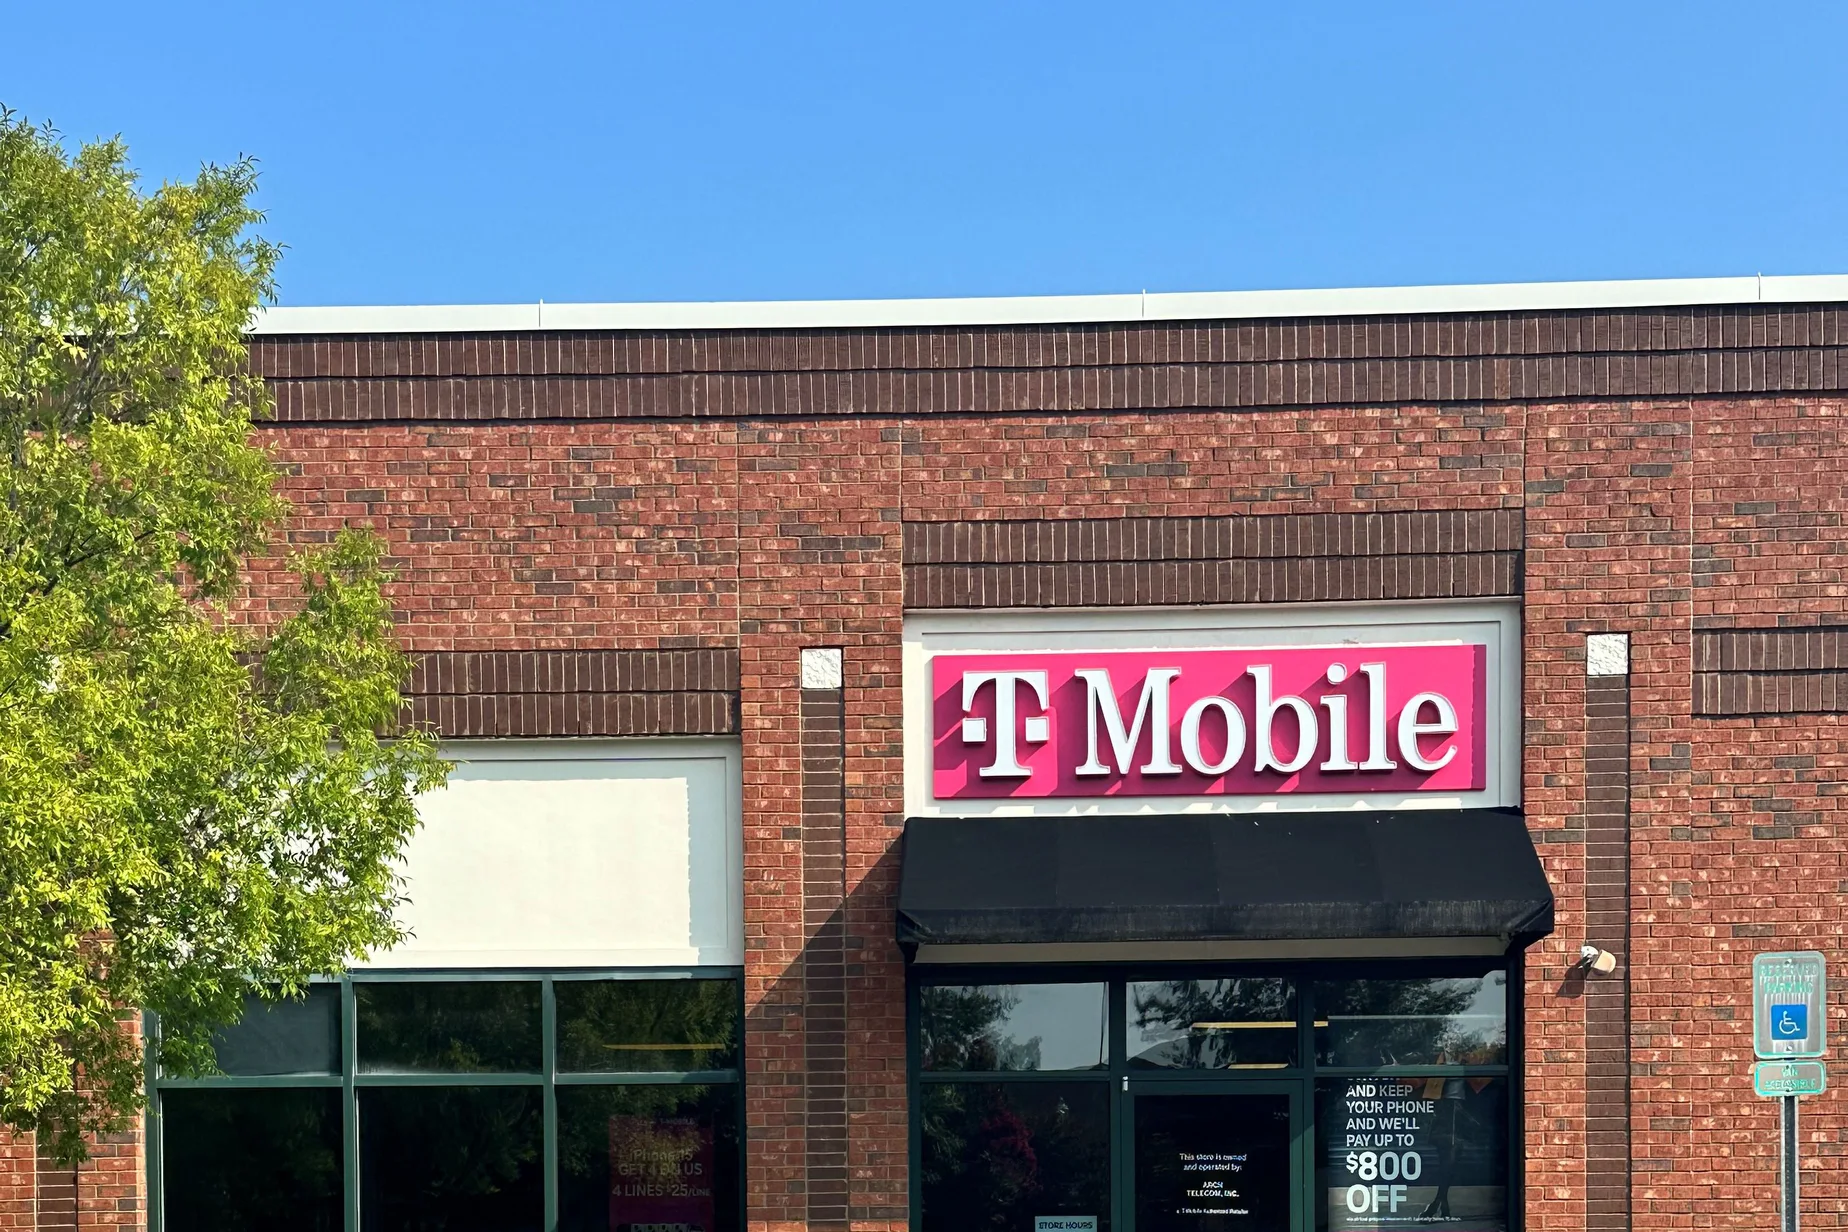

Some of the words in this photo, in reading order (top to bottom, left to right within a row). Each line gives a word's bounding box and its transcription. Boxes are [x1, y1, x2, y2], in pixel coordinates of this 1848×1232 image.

[1074, 661, 1459, 775] Mobile
[1346, 1084, 1376, 1097] AND
[1380, 1084, 1413, 1097] KEEP
[1346, 1101, 1383, 1113] YOUR
[1387, 1101, 1434, 1113] PHONE
[1346, 1118, 1376, 1130] AND
[1378, 1117, 1420, 1130] WE'LL
[1346, 1134, 1371, 1146] PAY
[1374, 1134, 1393, 1146] UP
[1396, 1134, 1414, 1146] TO
[619, 1163, 645, 1175] GET
[684, 1163, 702, 1175] US
[1346, 1151, 1421, 1181] $800
[612, 1184, 621, 1196] 4
[625, 1184, 663, 1196] LINES
[1346, 1184, 1407, 1213] OFF
